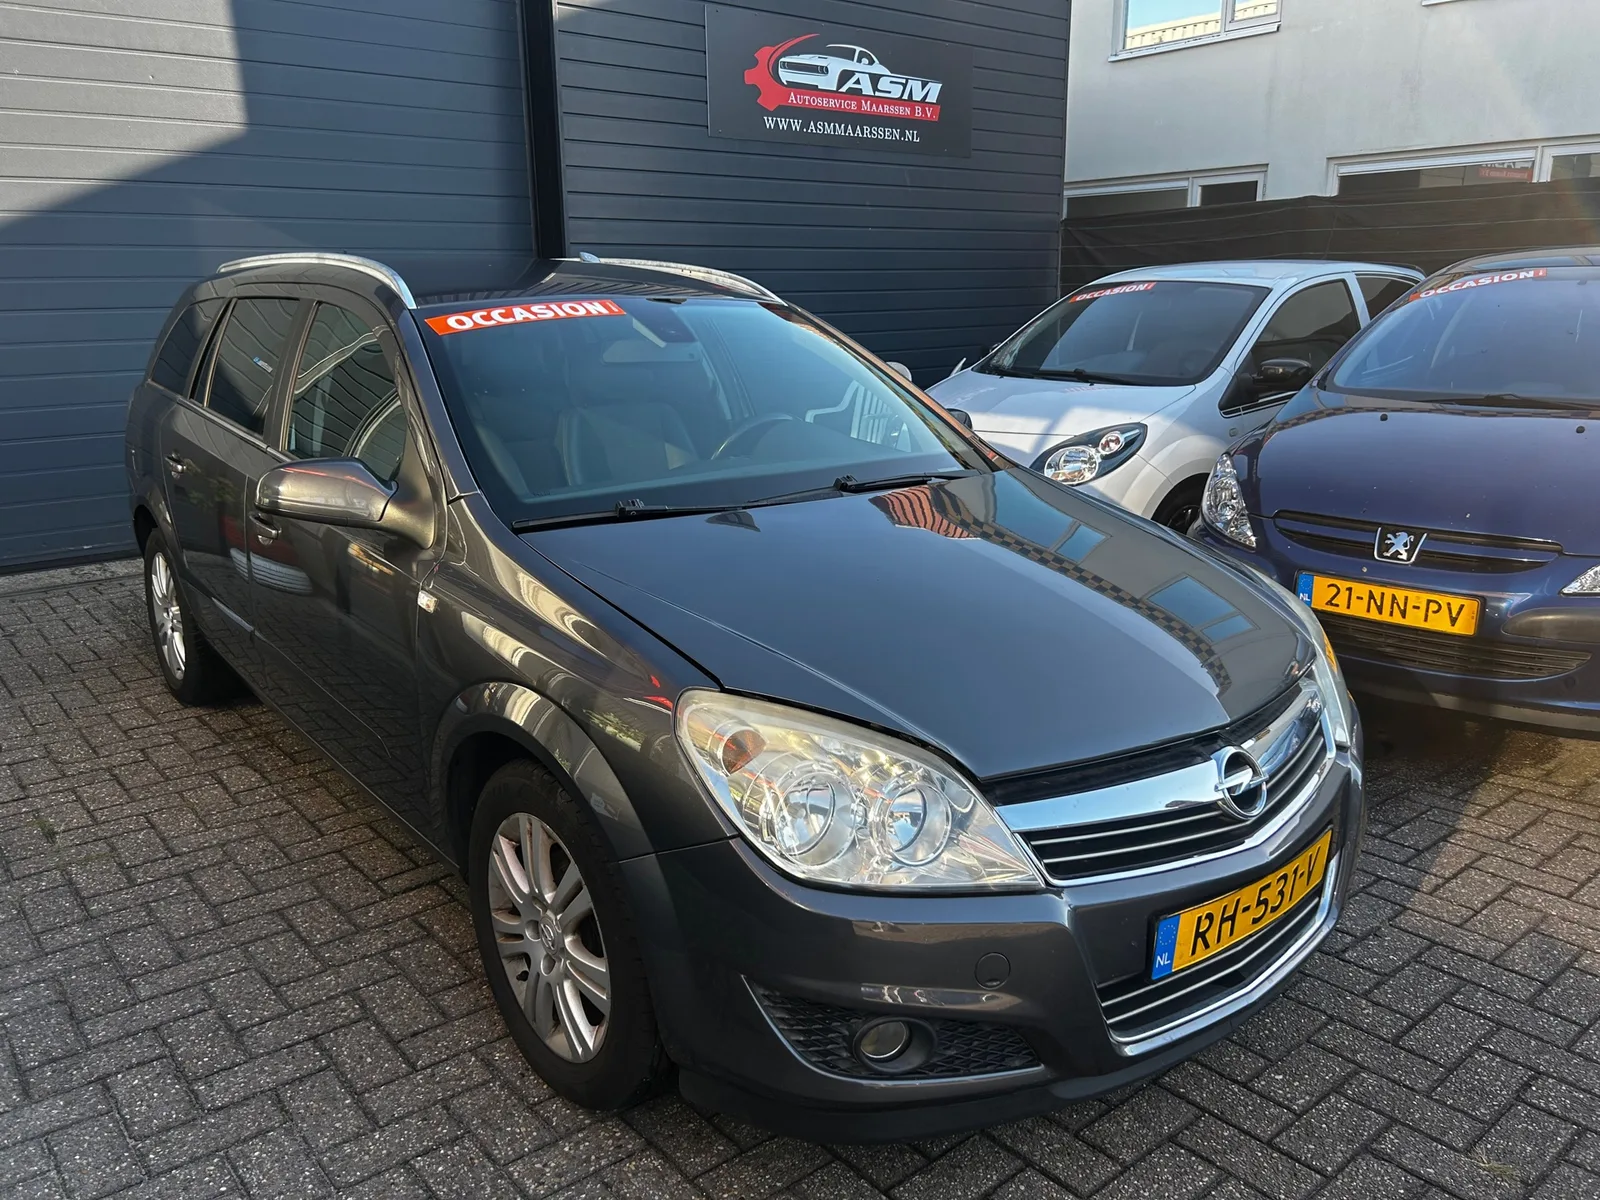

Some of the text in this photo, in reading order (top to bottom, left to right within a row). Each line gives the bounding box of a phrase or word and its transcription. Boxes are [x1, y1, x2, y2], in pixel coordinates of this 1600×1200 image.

[838, 72, 943, 103] ASM
[914, 105, 936, 118] B.V.
[763, 116, 920, 143] WWW.ASMMAARSSEN.NL
[1325, 583, 1465, 628] 21-NN-PV
[1155, 846, 1321, 968] NL RH-531-V
